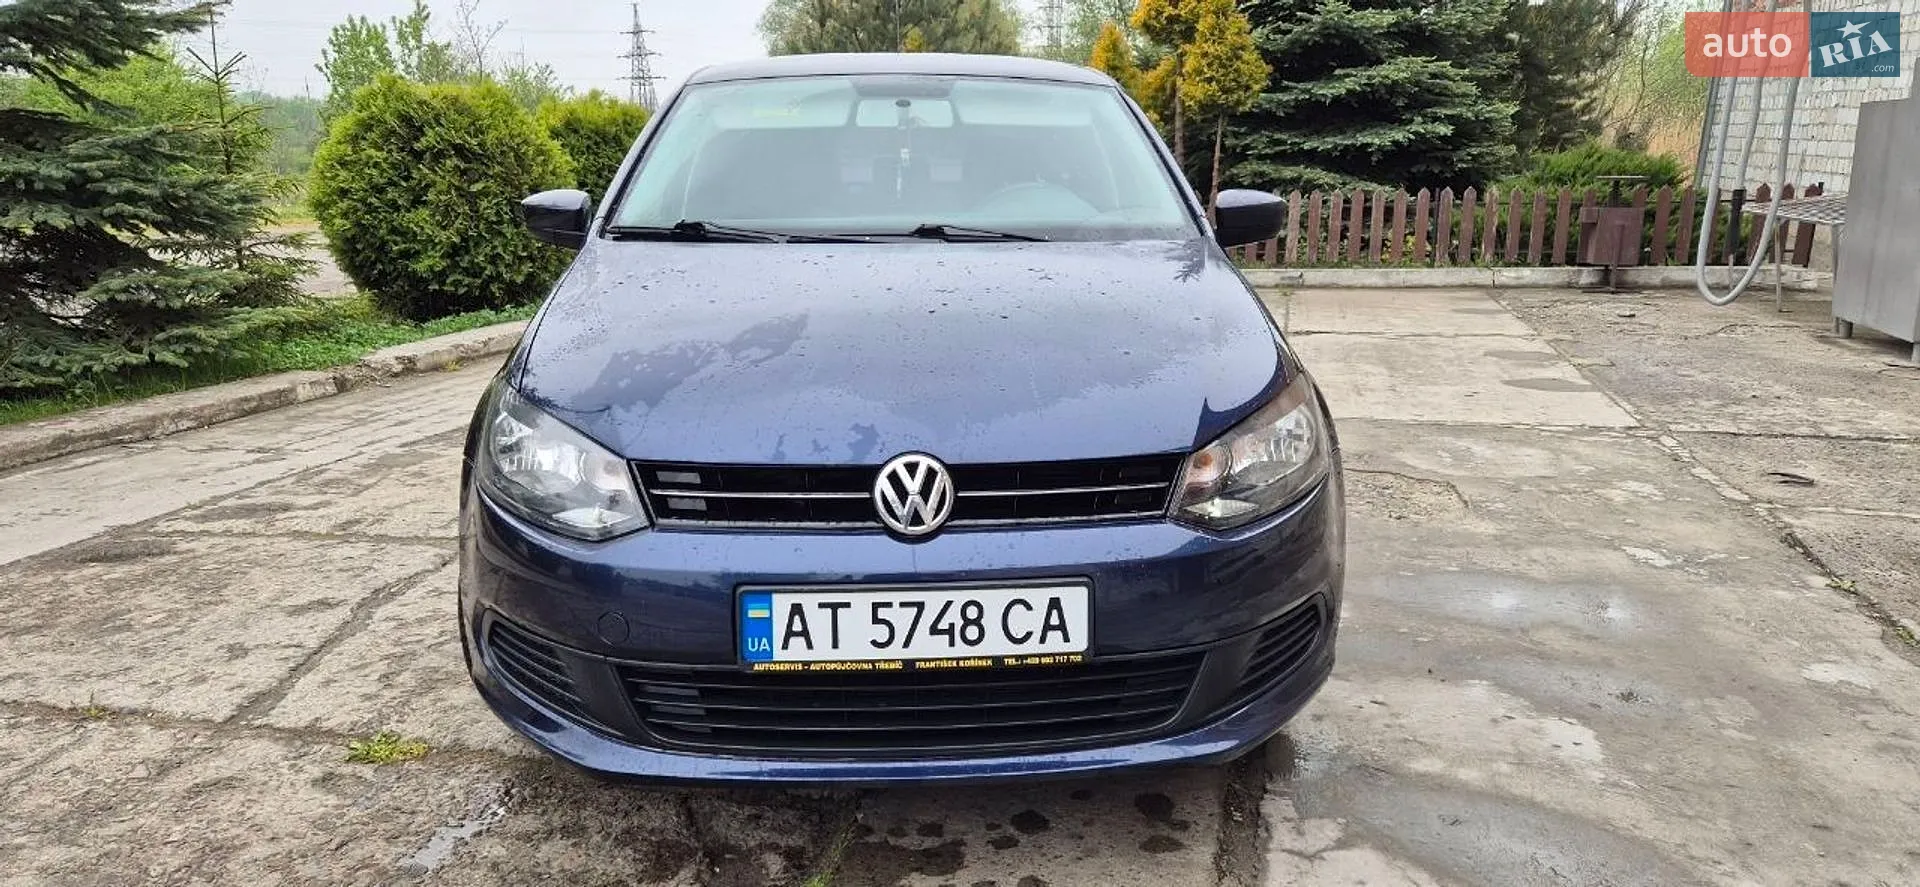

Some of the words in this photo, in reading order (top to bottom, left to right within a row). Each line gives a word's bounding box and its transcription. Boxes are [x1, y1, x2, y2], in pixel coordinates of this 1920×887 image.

[781, 601, 851, 650] AT
[870, 599, 985, 649] 5748
[1002, 597, 1071, 645] CA
[747, 637, 770, 652] UA
[753, 662, 802, 671] AUTOSERVIS
